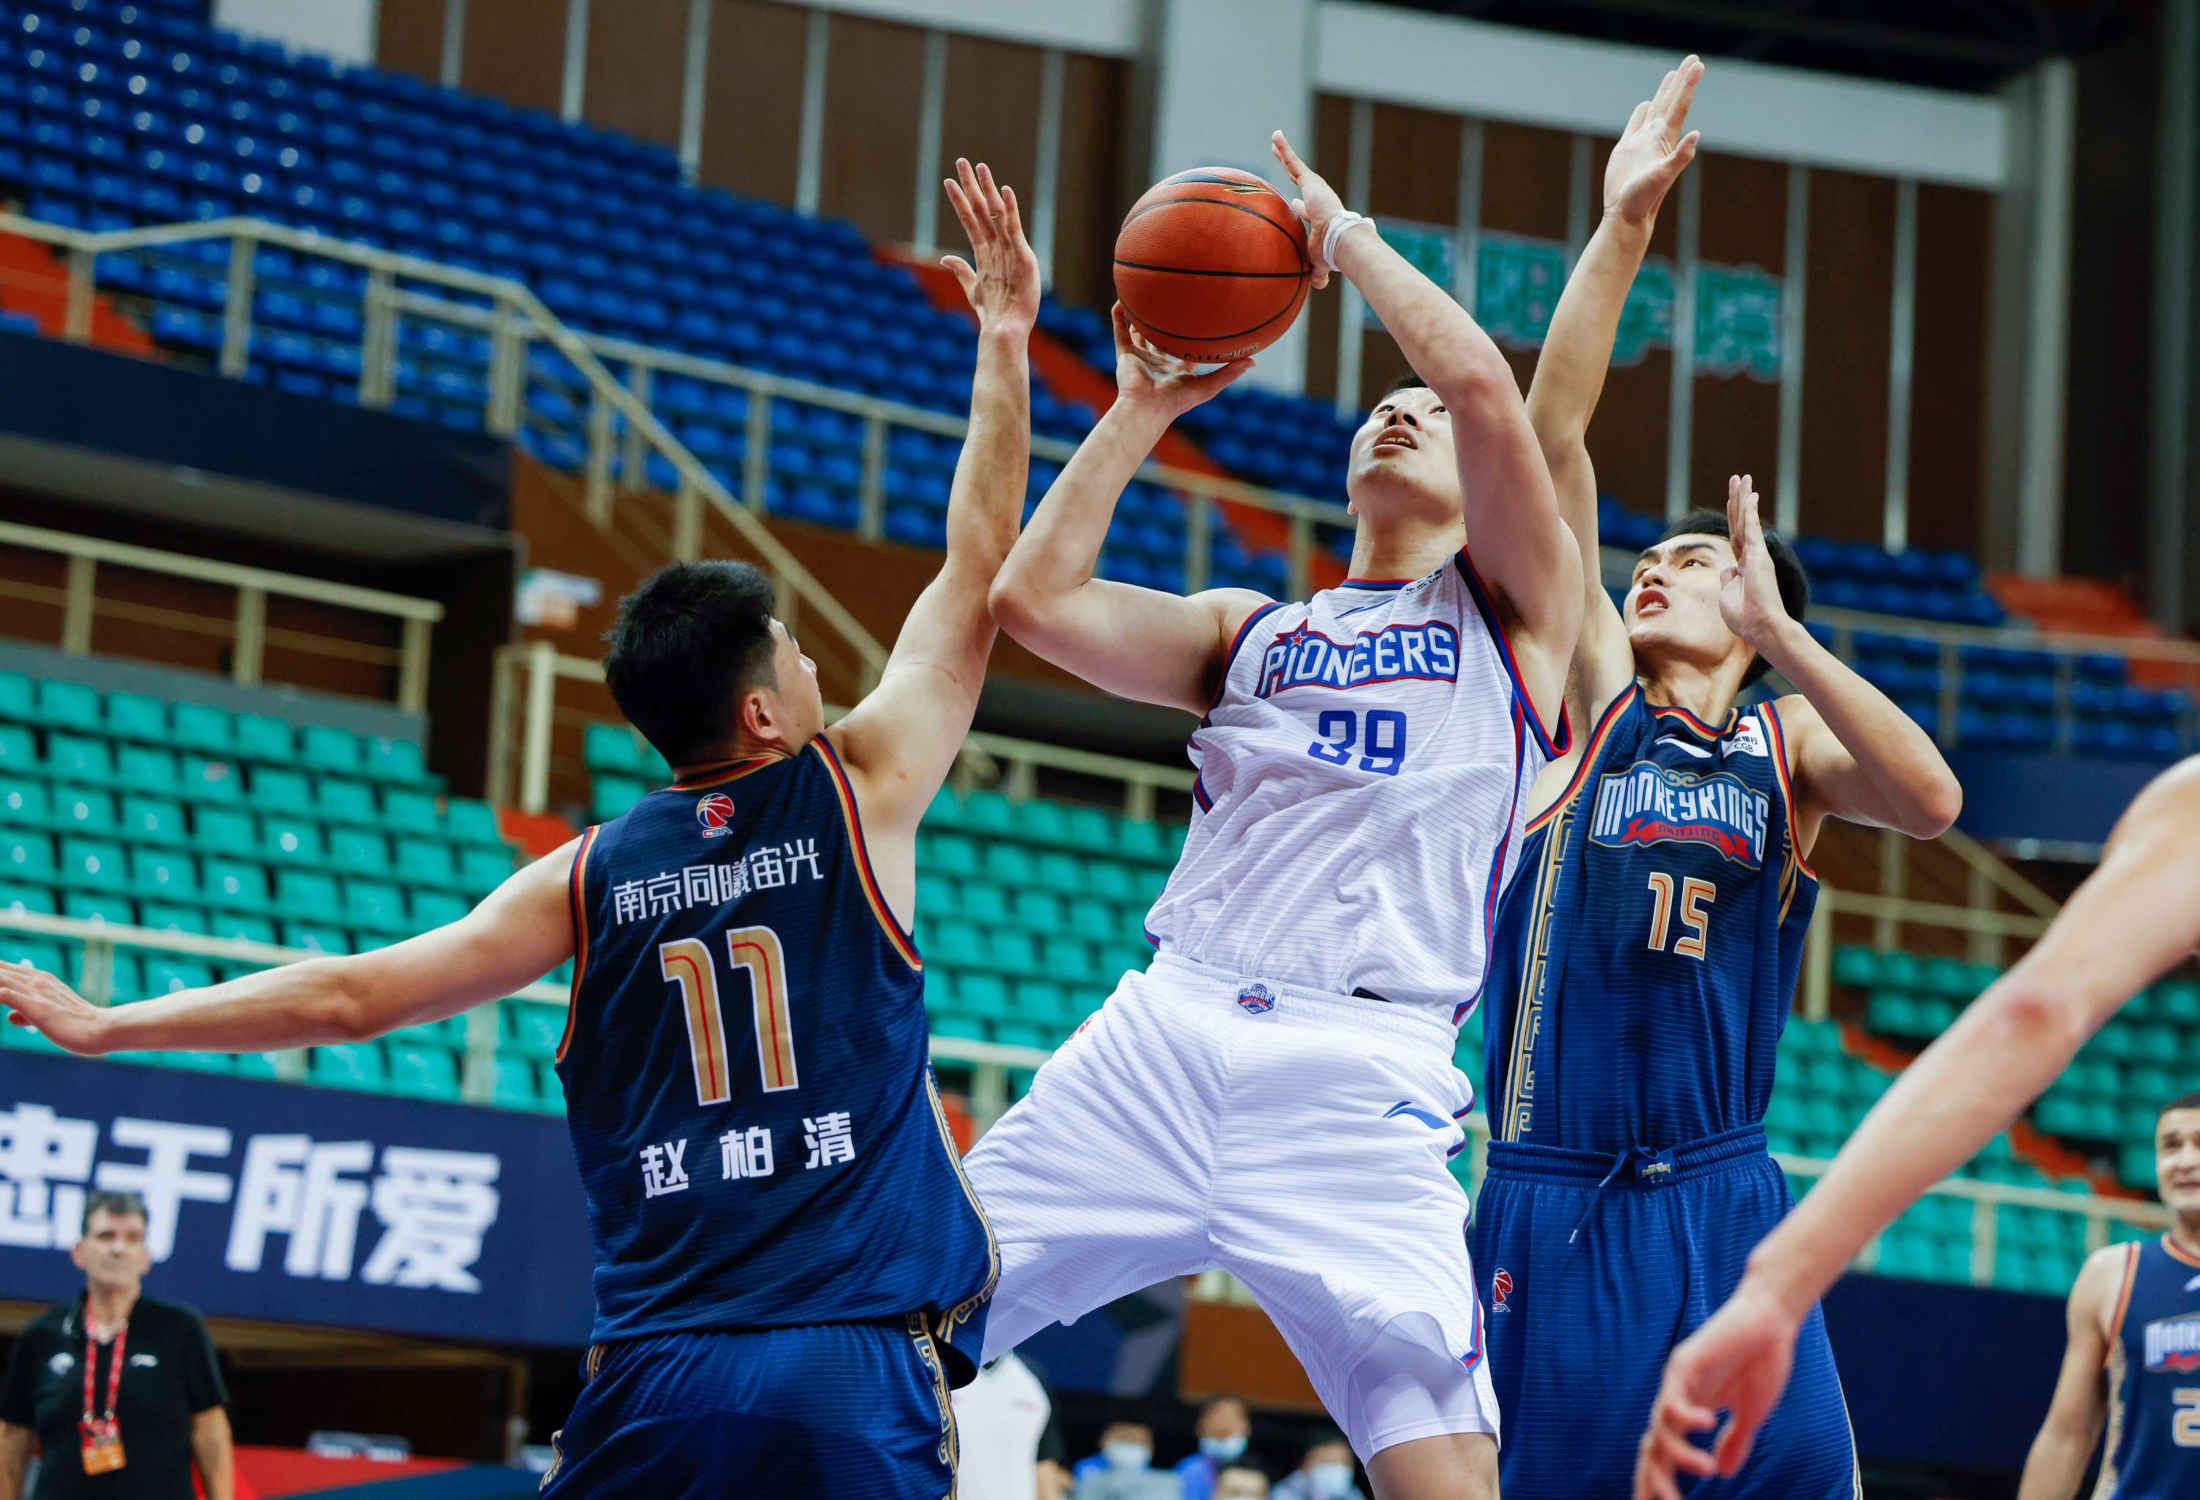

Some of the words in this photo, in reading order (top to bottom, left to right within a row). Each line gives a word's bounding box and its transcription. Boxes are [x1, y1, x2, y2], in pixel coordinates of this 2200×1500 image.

[1257, 624, 1458, 698] PIONEERS
[1308, 710, 1407, 776] 39
[612, 838, 824, 925] 南京同曦宙光
[1648, 872, 1716, 960] 15
[659, 925, 798, 1106] 11
